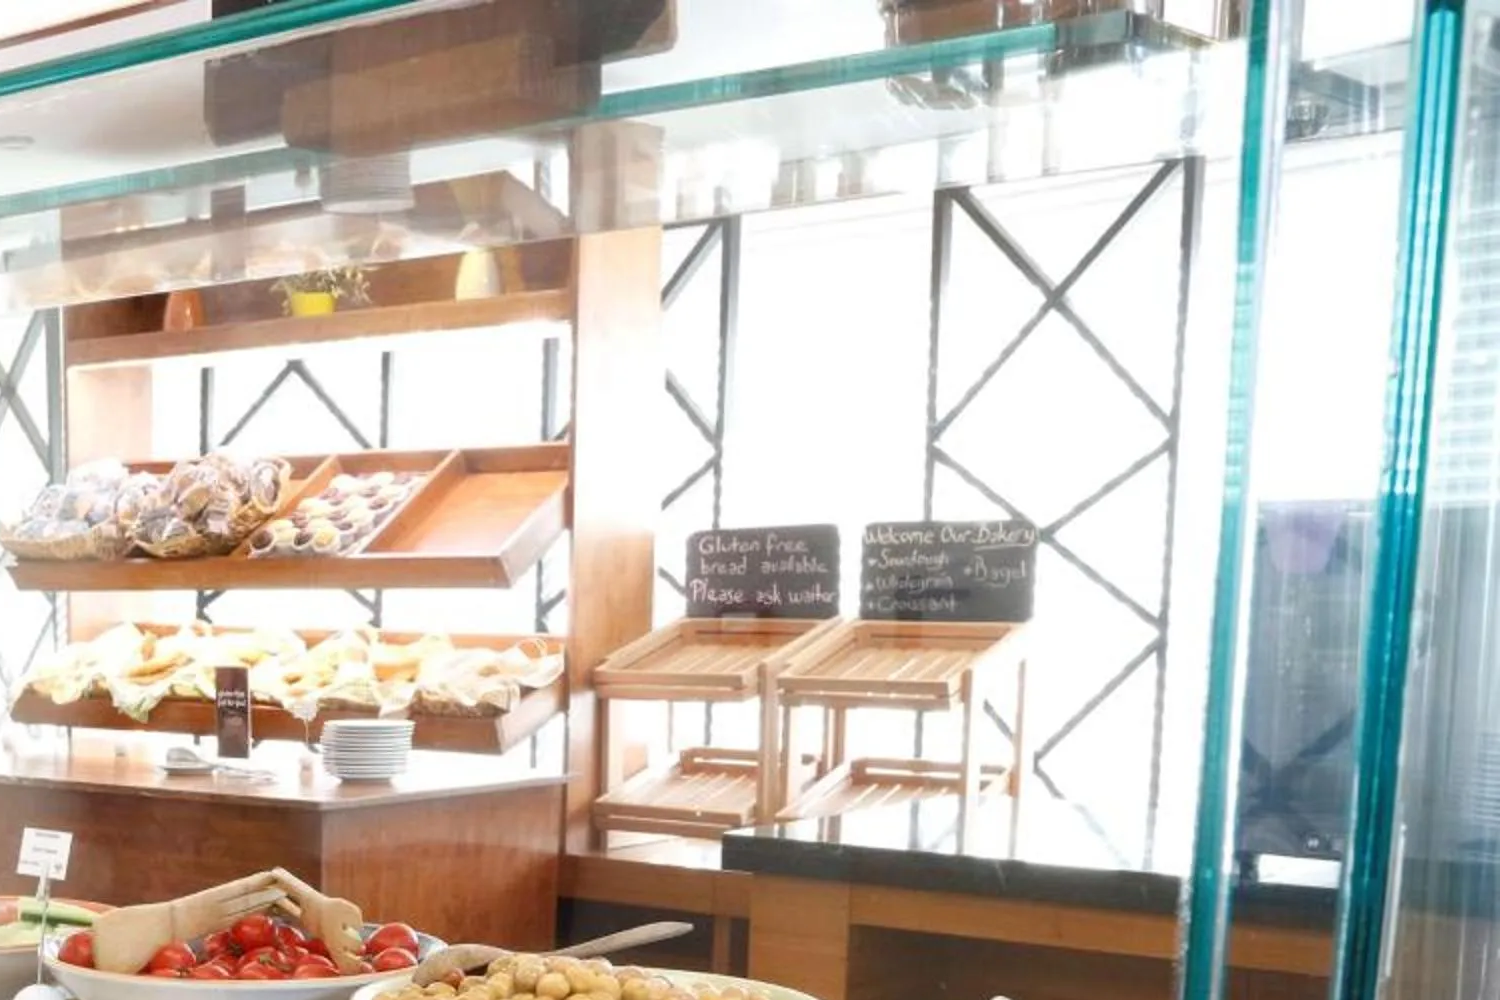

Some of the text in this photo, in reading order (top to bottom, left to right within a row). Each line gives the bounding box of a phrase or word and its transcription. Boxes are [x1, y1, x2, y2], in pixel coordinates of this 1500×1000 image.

[699, 533, 809, 557] Gluten free
[941, 525, 971, 544] Our
[700, 556, 747, 575] bread
[690, 577, 745, 604] Please
[756, 581, 783, 605] ask
